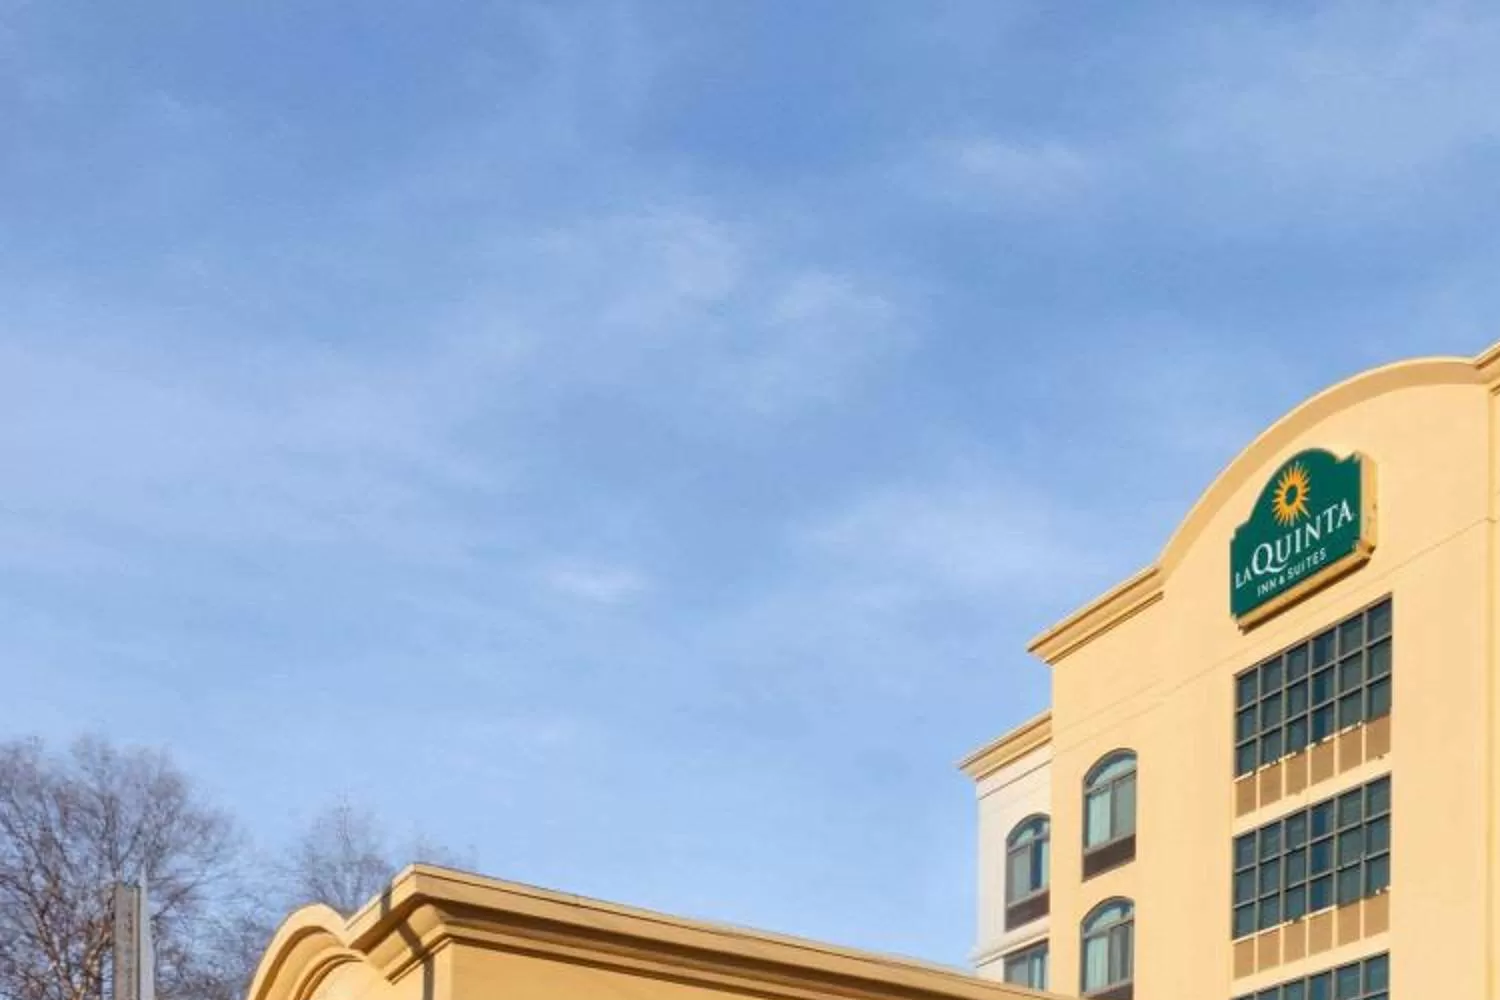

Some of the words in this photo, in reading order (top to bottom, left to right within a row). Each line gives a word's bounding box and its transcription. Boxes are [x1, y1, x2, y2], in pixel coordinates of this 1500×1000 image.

[1235, 565, 1253, 589] LA
[1251, 498, 1353, 576] QUINTA
[1257, 579, 1277, 597] INN
[1287, 547, 1327, 579] SUITES
